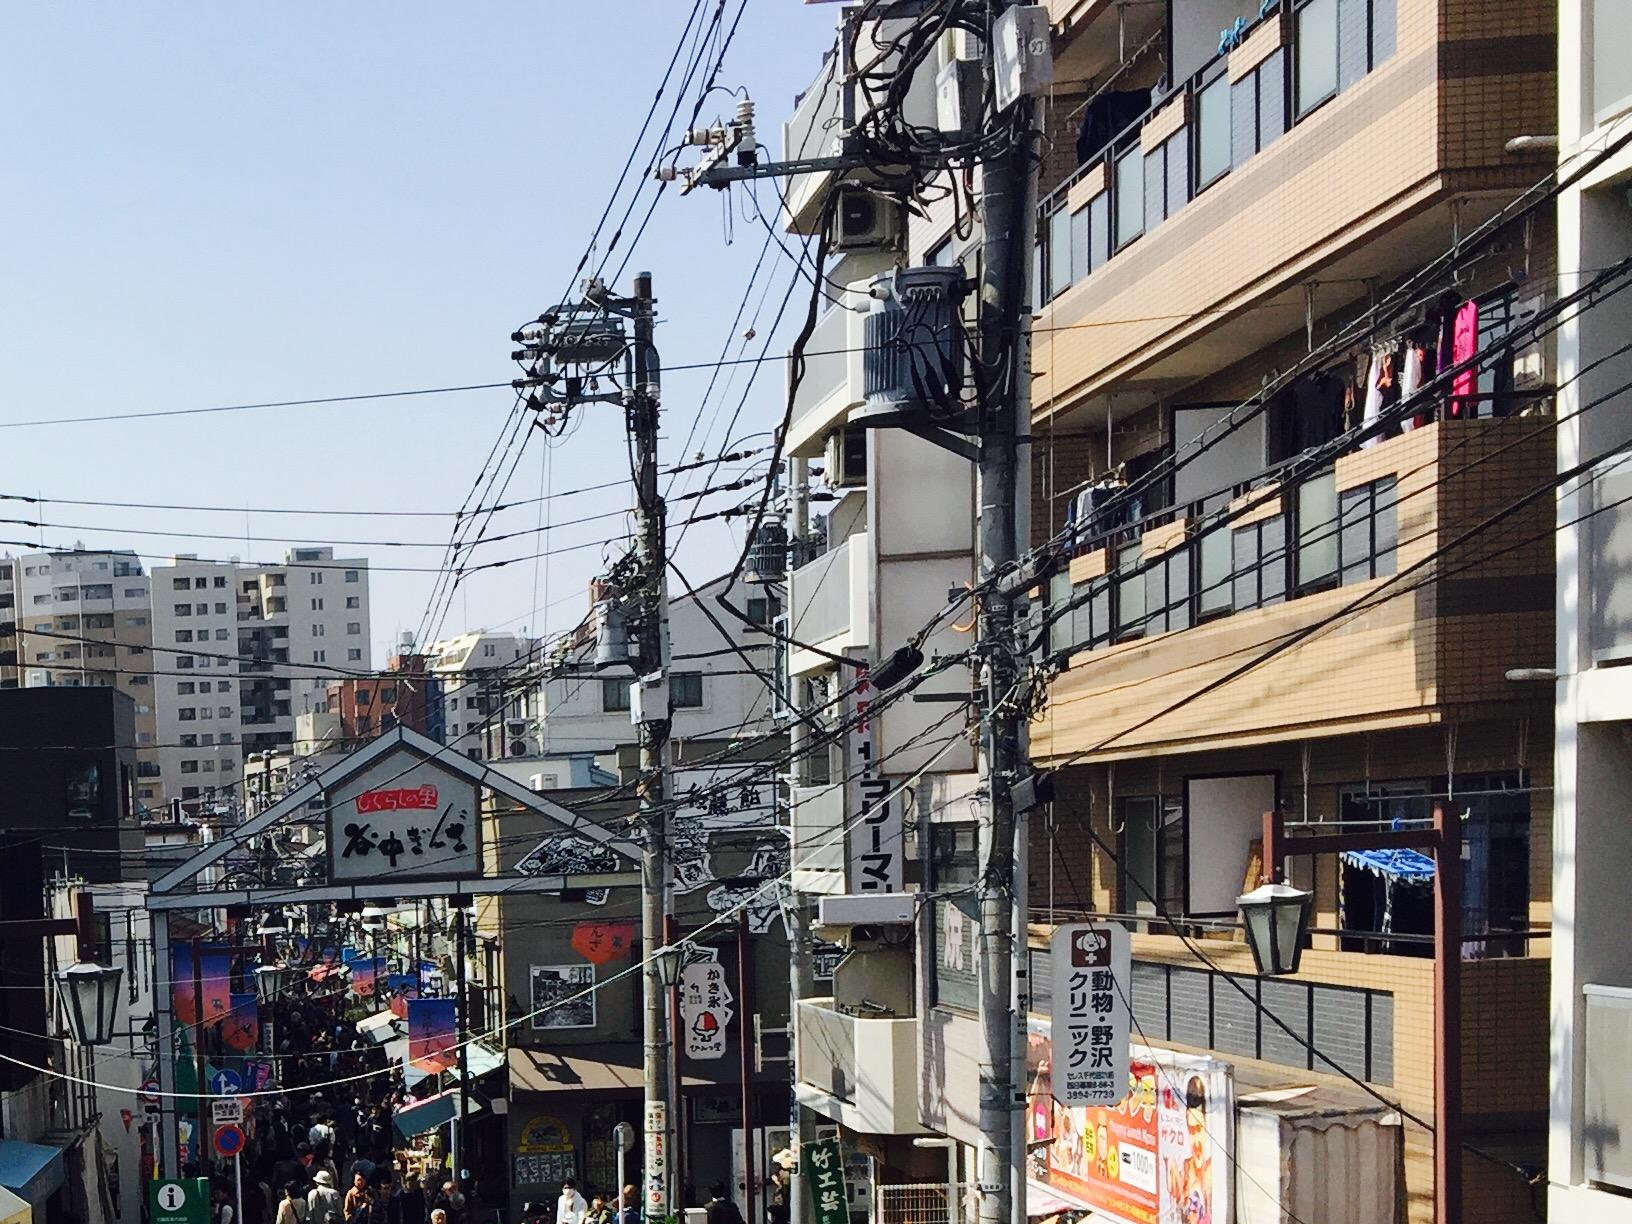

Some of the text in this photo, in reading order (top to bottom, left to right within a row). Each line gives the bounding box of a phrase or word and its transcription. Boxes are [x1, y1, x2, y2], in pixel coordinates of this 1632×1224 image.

[342, 802, 468, 867] 谷中ぎんざ
[707, 968, 721, 1009] かき氷
[1067, 971, 1089, 1068] クリニック
[1091, 970, 1114, 1068] 動物・野沢
[811, 1147, 840, 1212] 竹工芸
